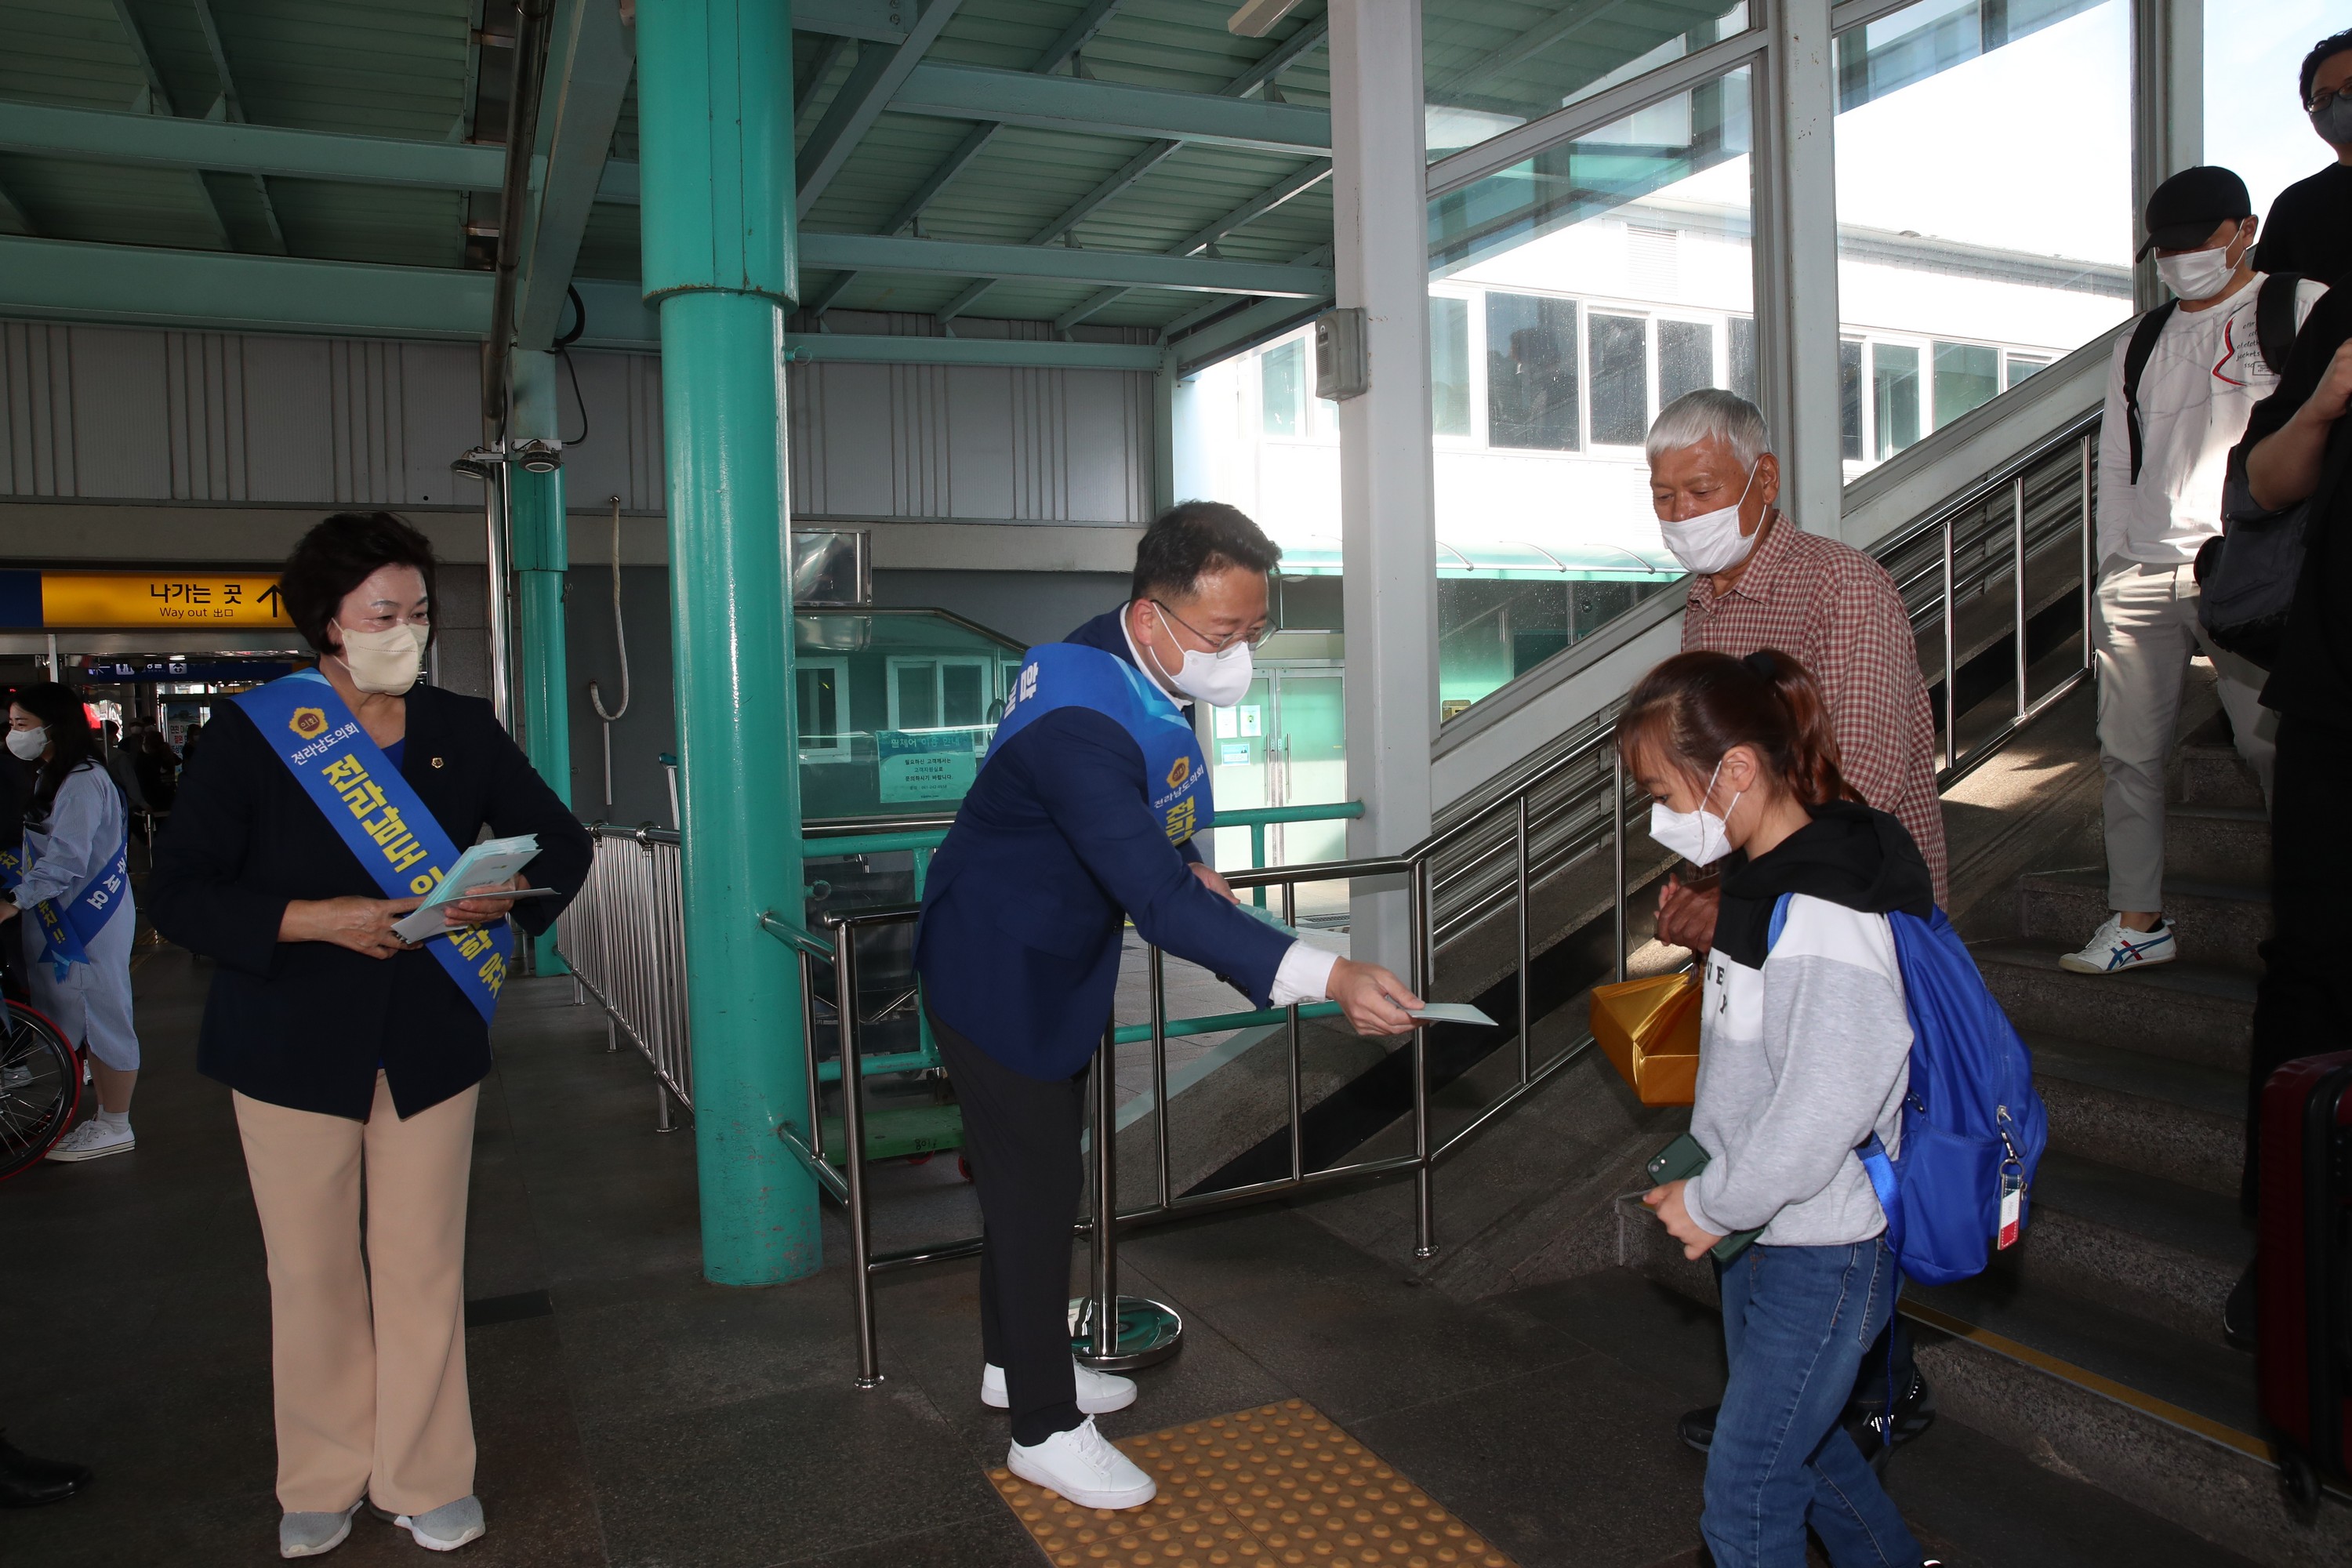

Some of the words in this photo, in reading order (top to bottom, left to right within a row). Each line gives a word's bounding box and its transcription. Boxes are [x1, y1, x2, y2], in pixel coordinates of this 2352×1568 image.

[151, 584, 211, 604] 나가는
[223, 584, 241, 604] 곳
[160, 607, 184, 619] Way
[188, 608, 208, 618] out
[213, 608, 234, 618] 出口
[300, 716, 318, 730] 의회
[291, 722, 360, 766] 전라남도의회
[891, 739, 917, 749] 휠체어
[921, 737, 938, 747] 이용
[942, 737, 960, 747] 안내
[1154, 764, 1204, 808] 전라남도의회
[321, 753, 428, 873] 전라남도
